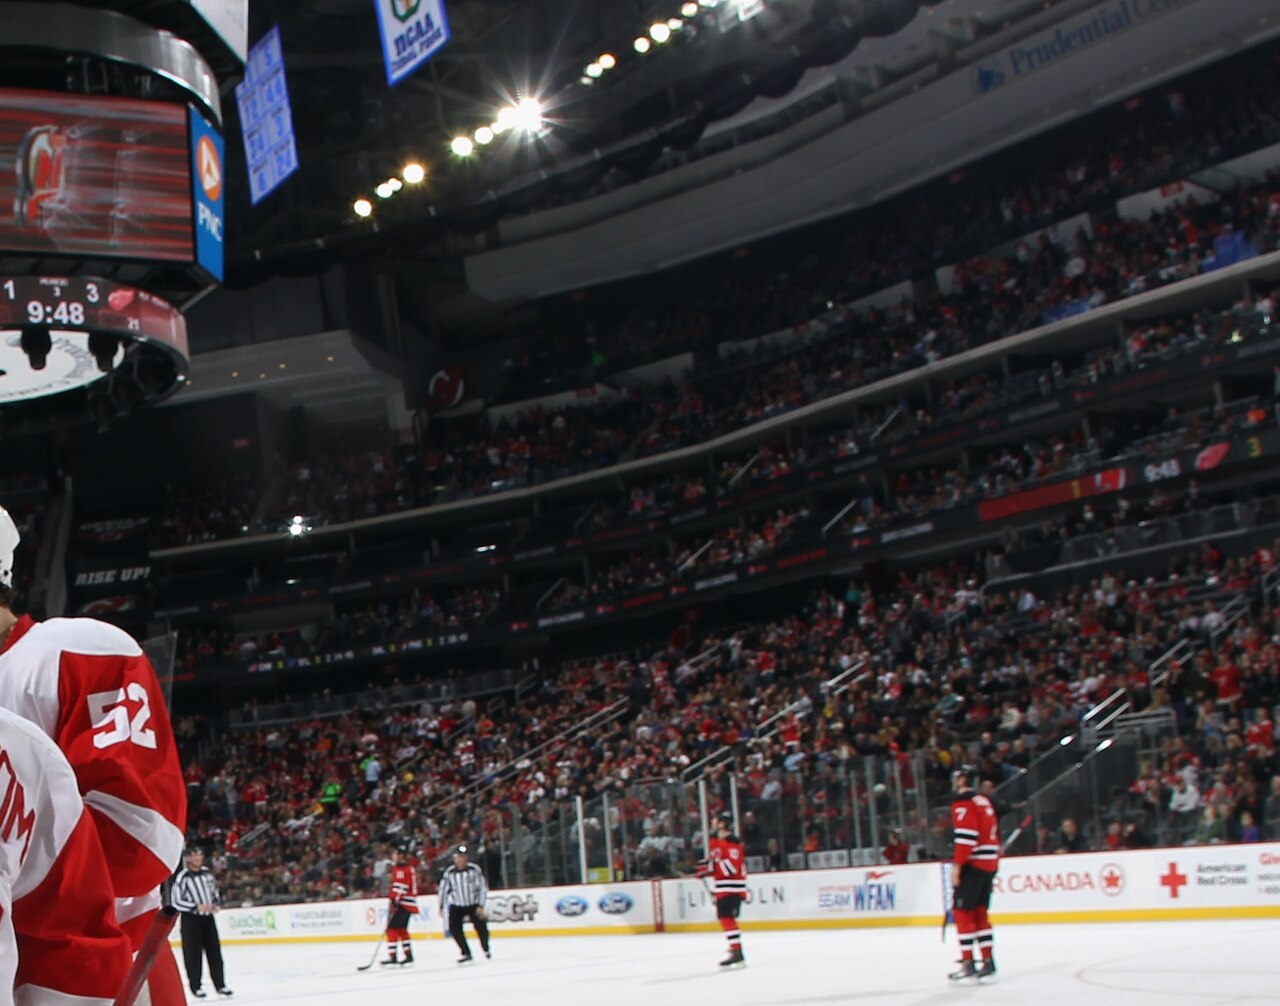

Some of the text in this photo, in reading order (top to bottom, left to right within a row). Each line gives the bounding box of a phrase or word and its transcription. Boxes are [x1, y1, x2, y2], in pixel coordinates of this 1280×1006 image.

[1009, 0, 1132, 75] Prudential
[198, 201, 222, 241] PNC
[3, 280, 16, 300] 1
[86, 283, 100, 303] 3
[27, 301, 86, 325] 9:48
[74, 566, 152, 586] RISE UP!
[86, 682, 159, 750] 52
[1198, 863, 1247, 874] American
[1198, 875, 1216, 886] Red
[1219, 874, 1248, 886] Cross
[1007, 872, 1095, 893] CANADA
[852, 883, 896, 911] WFAN
